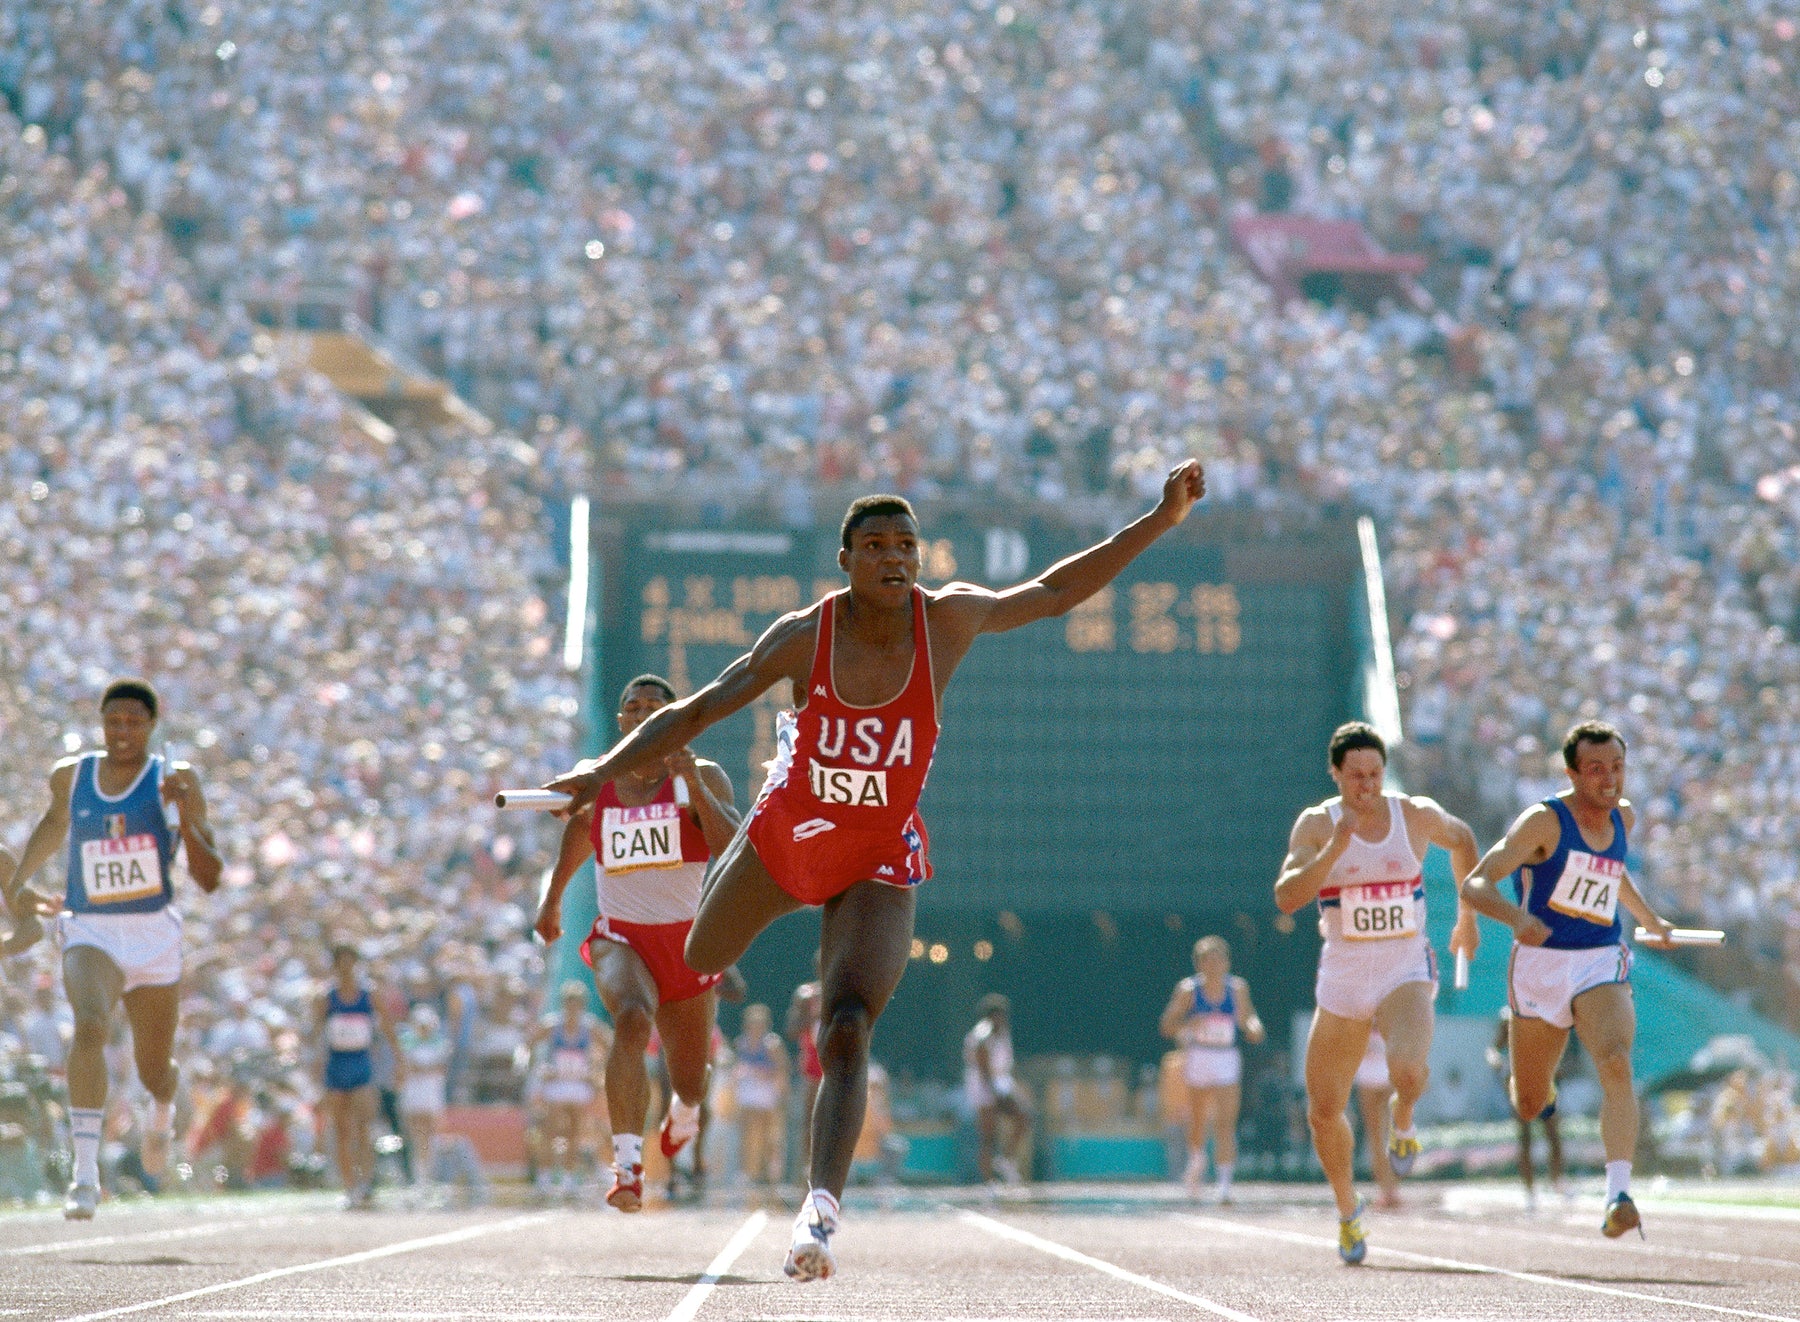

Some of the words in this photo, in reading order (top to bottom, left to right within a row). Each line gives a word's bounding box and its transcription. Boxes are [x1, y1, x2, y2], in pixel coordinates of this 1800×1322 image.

[817, 715, 914, 768] USA
[809, 764, 886, 807] USA
[611, 825, 671, 860] CAN
[94, 859, 147, 890] FRA
[1568, 876, 1610, 911] ITA
[1353, 904, 1404, 932] GBR
